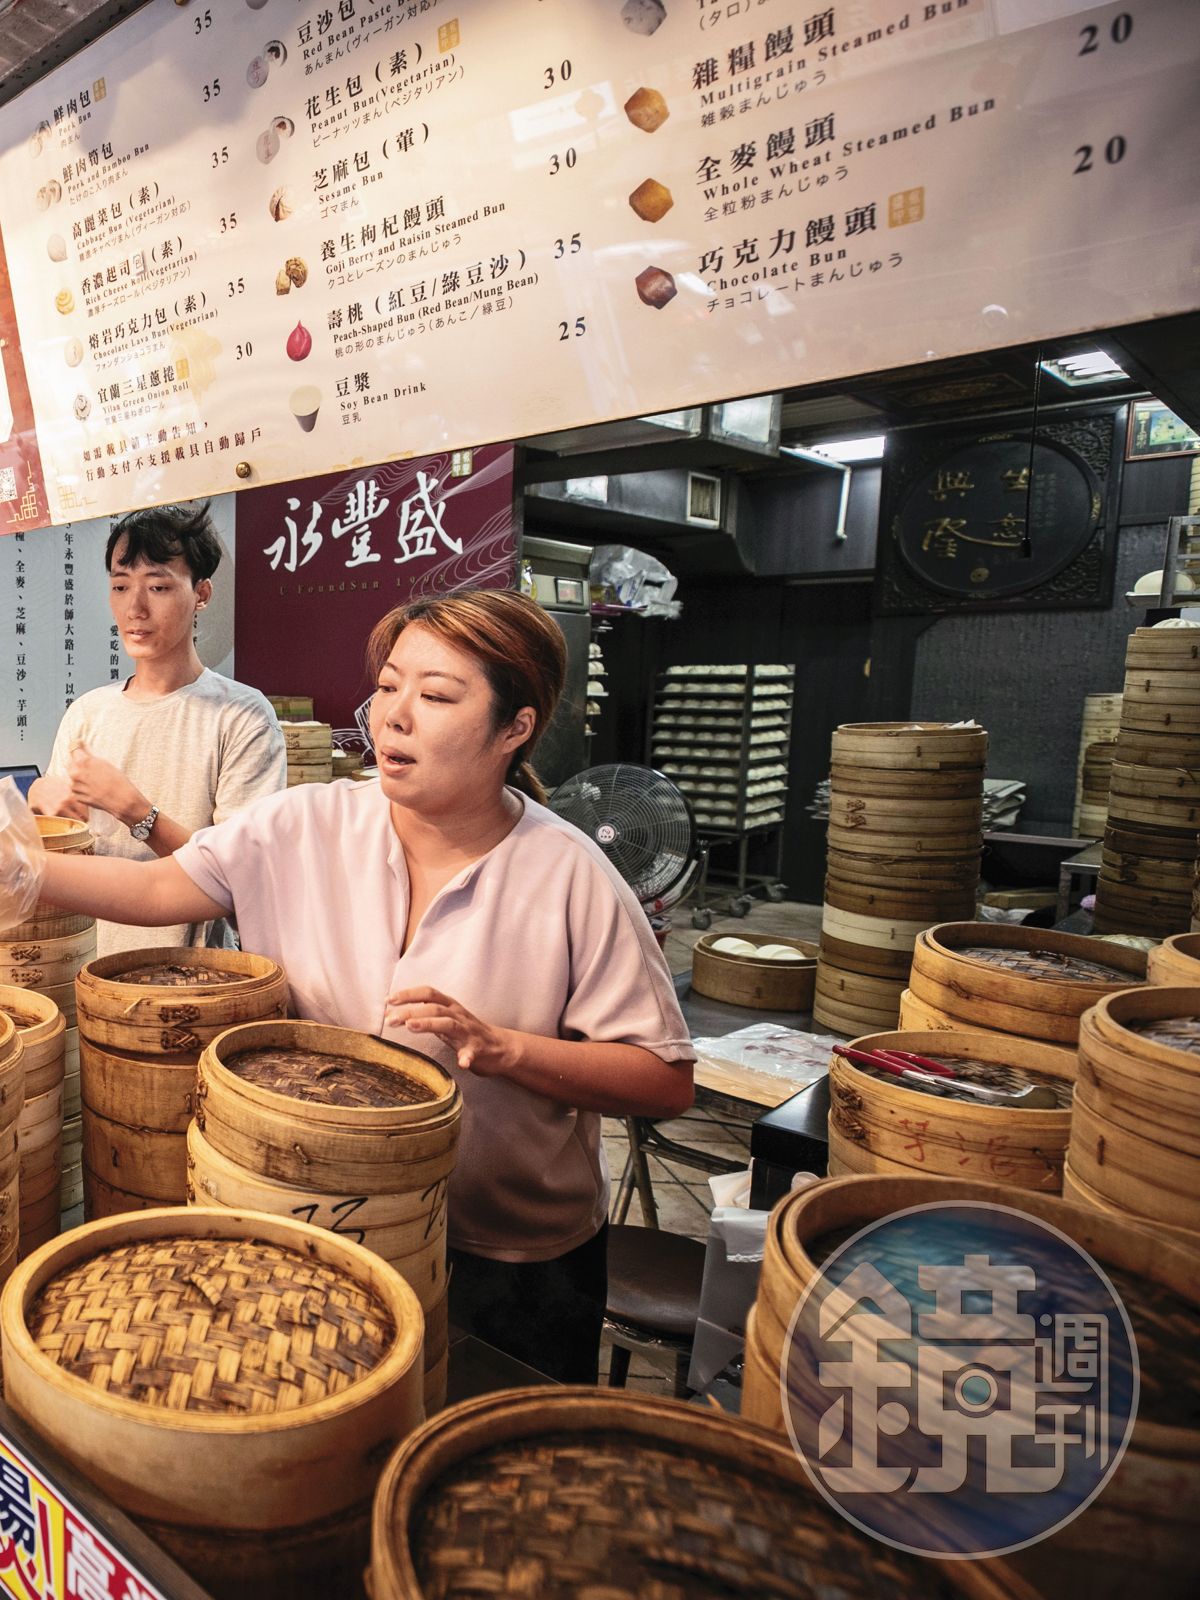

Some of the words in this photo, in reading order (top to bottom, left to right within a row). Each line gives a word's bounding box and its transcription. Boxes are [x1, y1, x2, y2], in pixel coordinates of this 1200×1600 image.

[193, 10, 214, 36] 35
[303, 42, 322, 60] Red
[328, 25, 355, 46] Bean
[360, 4, 391, 28] Paste
[1078, 13, 1133, 56] 20
[692, 7, 835, 90] 雜糧饅頭
[700, 57, 806, 107] Multigrain
[818, 14, 910, 62] Steamed
[923, 0, 968, 22] Bun
[203, 78, 222, 103] 35
[311, 109, 348, 133] Peanut
[353, 54, 455, 112] Bun(Vegetarian)
[543, 59, 573, 89] 30
[53, 90, 91, 126] 鮮肉包
[701, 70, 827, 128] 雑穀まんじゅう
[58, 123, 76, 137] Pork
[78, 112, 92, 123] Bun
[62, 142, 114, 184] 鮮肉筍包
[67, 181, 84, 194] Pork
[88, 171, 99, 183] and
[102, 154, 131, 175] Bamboo
[134, 143, 150, 157] Bun
[211, 145, 230, 170] 35
[548, 147, 578, 176] 30
[696, 112, 836, 185] 全麥饅頭
[703, 174, 759, 201] Whole
[769, 151, 832, 180] Wheat
[842, 114, 937, 157] Steamed
[950, 98, 996, 123] Bun
[1073, 135, 1128, 175] 20
[319, 183, 357, 204] Sesame
[362, 171, 384, 186] Bun
[320, 195, 360, 219] ゴマまん
[704, 165, 848, 222] 全粒粉まんじゅう
[77, 228, 106, 251] Cabbage
[108, 221, 123, 234] Bun
[125, 196, 175, 228] (Vegetarian)
[220, 212, 238, 234] 35
[320, 195, 446, 262] 養生枸杞饅頭
[326, 259, 345, 276] Goji
[349, 249, 374, 268] Berry
[378, 241, 395, 256] and
[399, 230, 431, 248] Raisin
[434, 210, 479, 236] Steamed
[483, 201, 506, 217] Bun
[698, 202, 877, 274] 巧克力饅頭
[328, 233, 462, 290] クコとレーズンのまんじゅう
[554, 232, 583, 260] 35
[227, 277, 245, 299] 35
[707, 259, 799, 292] Chocolate
[809, 248, 848, 268] Bun
[707, 252, 903, 313] チョコレートまんじゅう
[85, 294, 101, 306] Rich
[103, 282, 128, 298] Cheese
[333, 317, 394, 344] Peach-Shaped
[397, 312, 416, 325] Bun
[418, 302, 441, 320] (Red
[445, 284, 503, 310] Bean/Mung
[507, 272, 539, 294] Bean)
[93, 341, 129, 361] Chocolate
[131, 335, 149, 348] Lava
[558, 317, 588, 343] 25
[236, 341, 253, 361] 30
[102, 403, 121, 415] Yilan
[123, 395, 144, 408] Green
[147, 388, 170, 401] Onion
[173, 381, 189, 393] Roll
[335, 372, 371, 398] 豆漿
[340, 399, 358, 412] Soy
[363, 392, 388, 406] Bean
[394, 382, 427, 398] Drink
[342, 412, 362, 426] 豆乳
[86, 428, 262, 482] 行動支付不支援載具自動歸戶
[263, 471, 464, 573] 永豐盛
